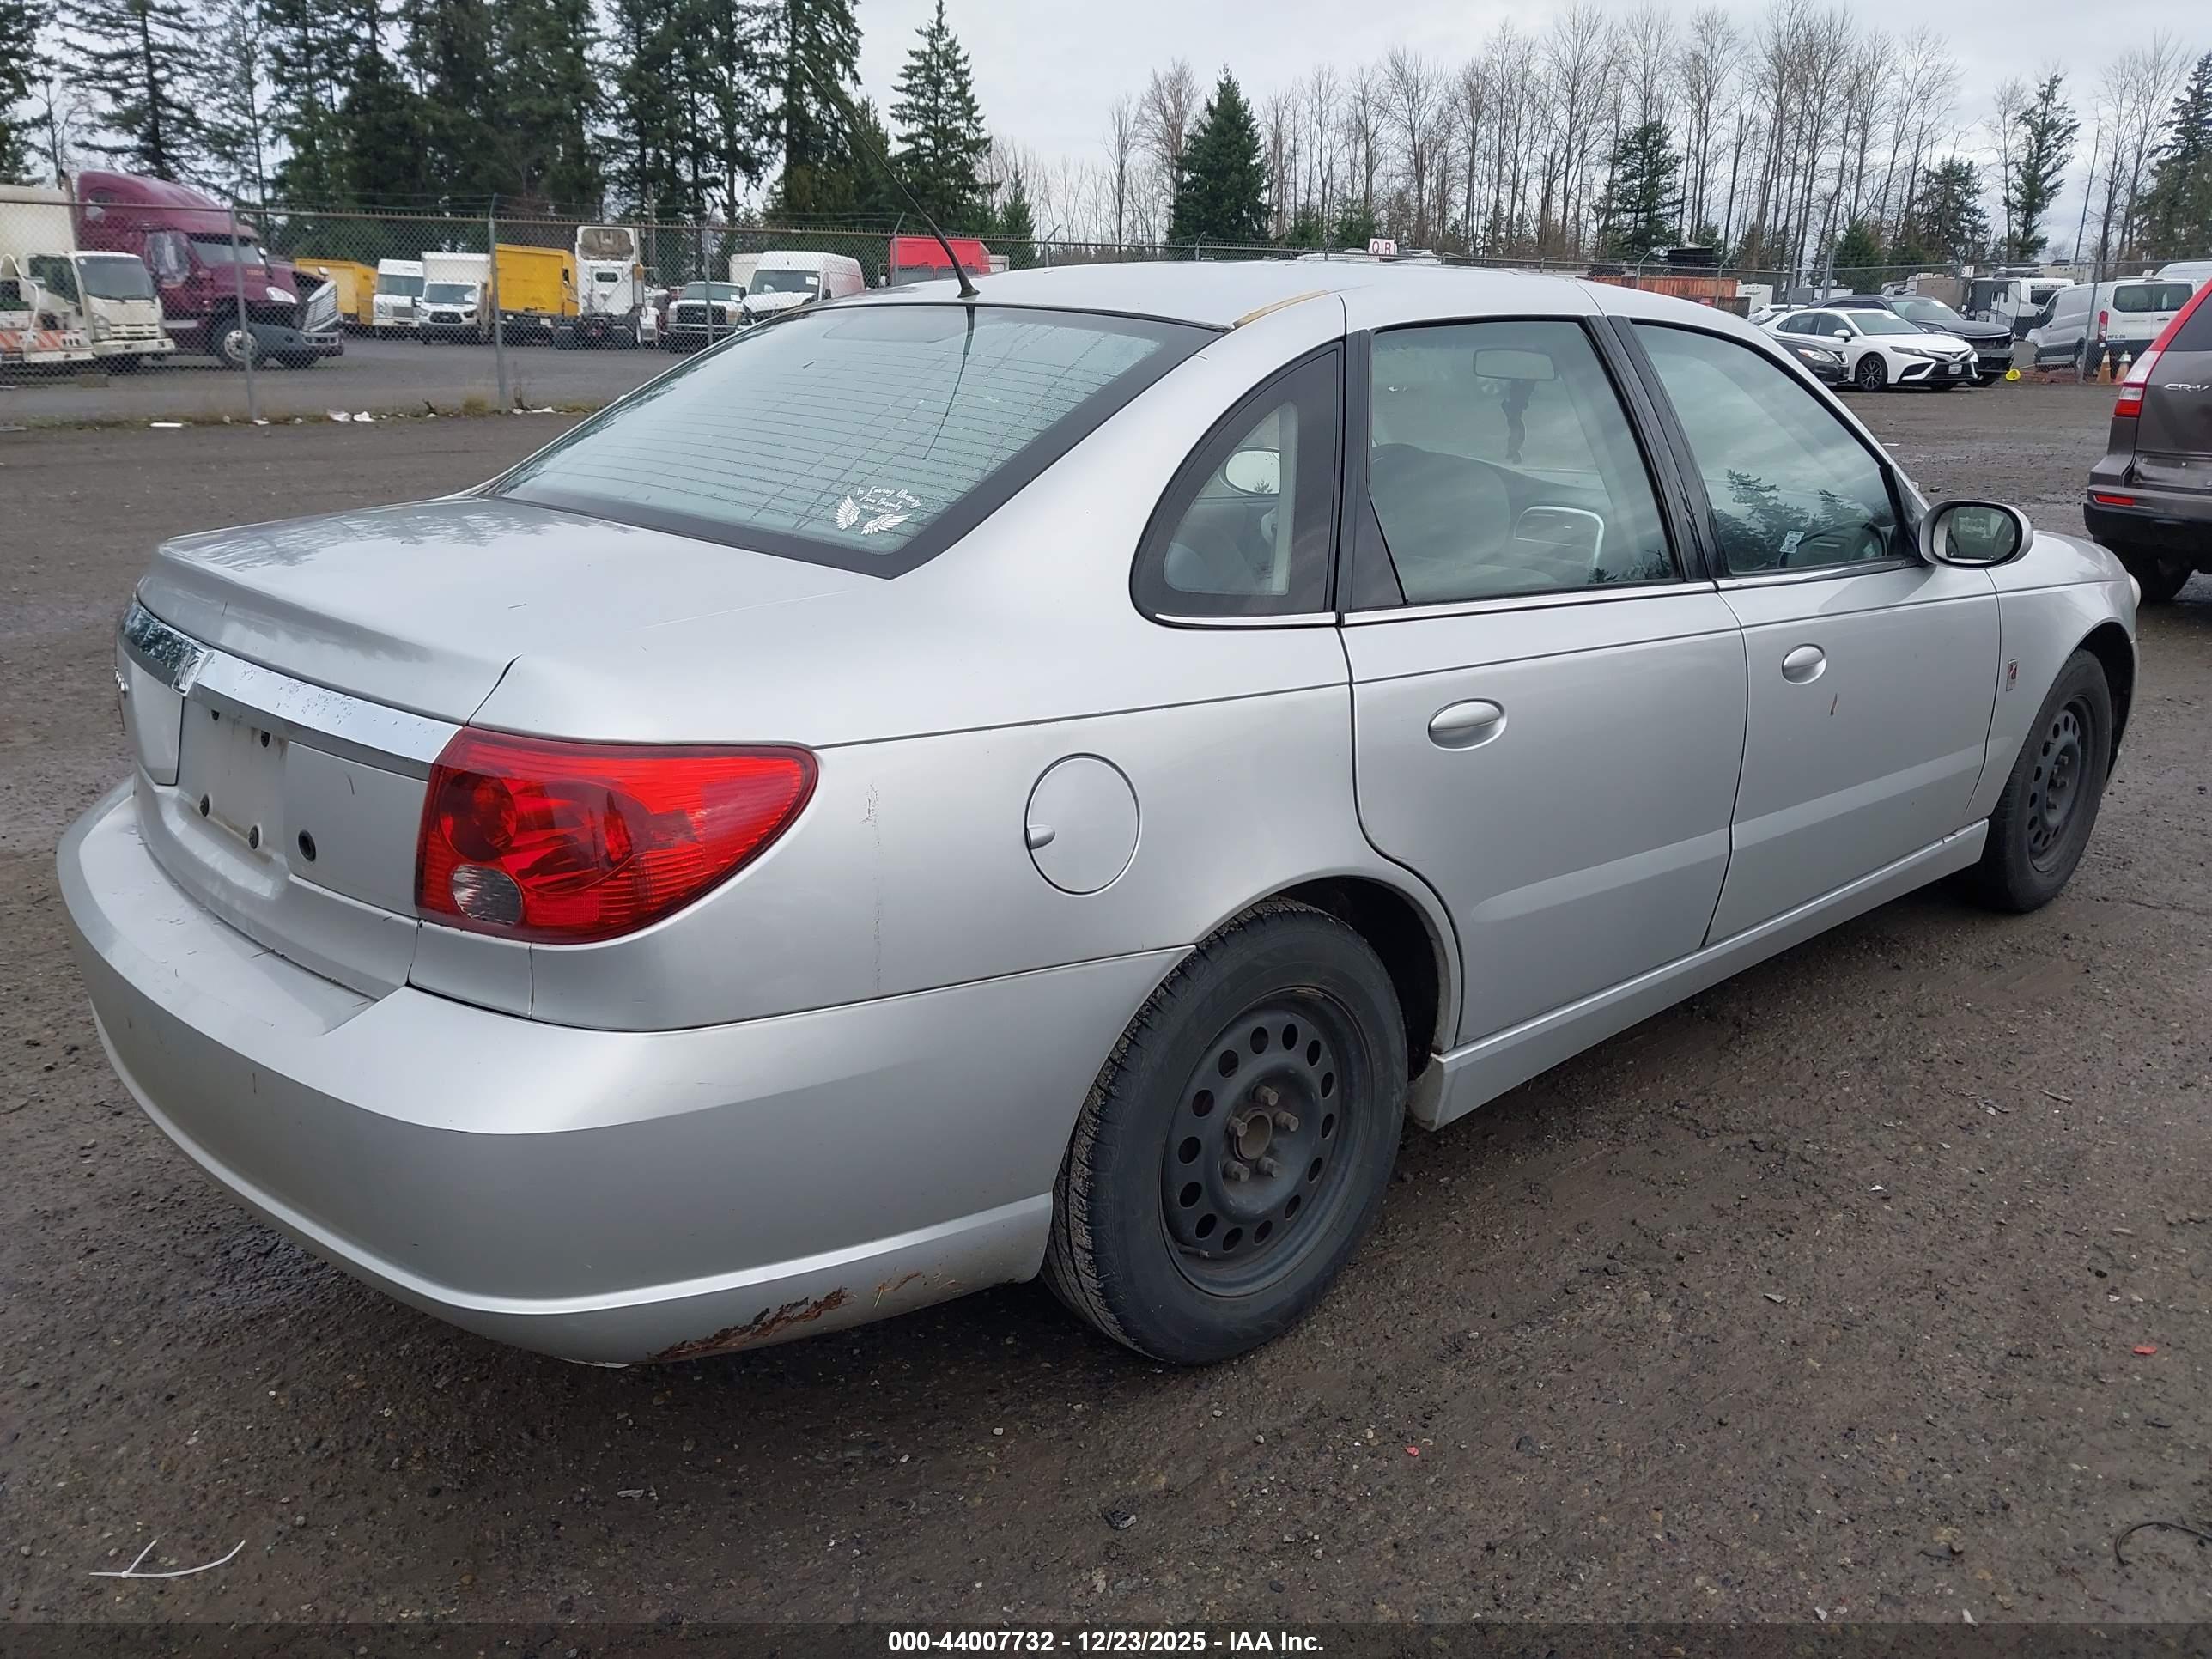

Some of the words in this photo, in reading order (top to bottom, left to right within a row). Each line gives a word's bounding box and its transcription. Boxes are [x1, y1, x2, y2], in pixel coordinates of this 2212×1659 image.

[1372, 241, 1380, 254] Q
[1385, 242, 1392, 255] R
[2164, 383, 2211, 392] CR-V
[867, 486, 895, 497] Loving
